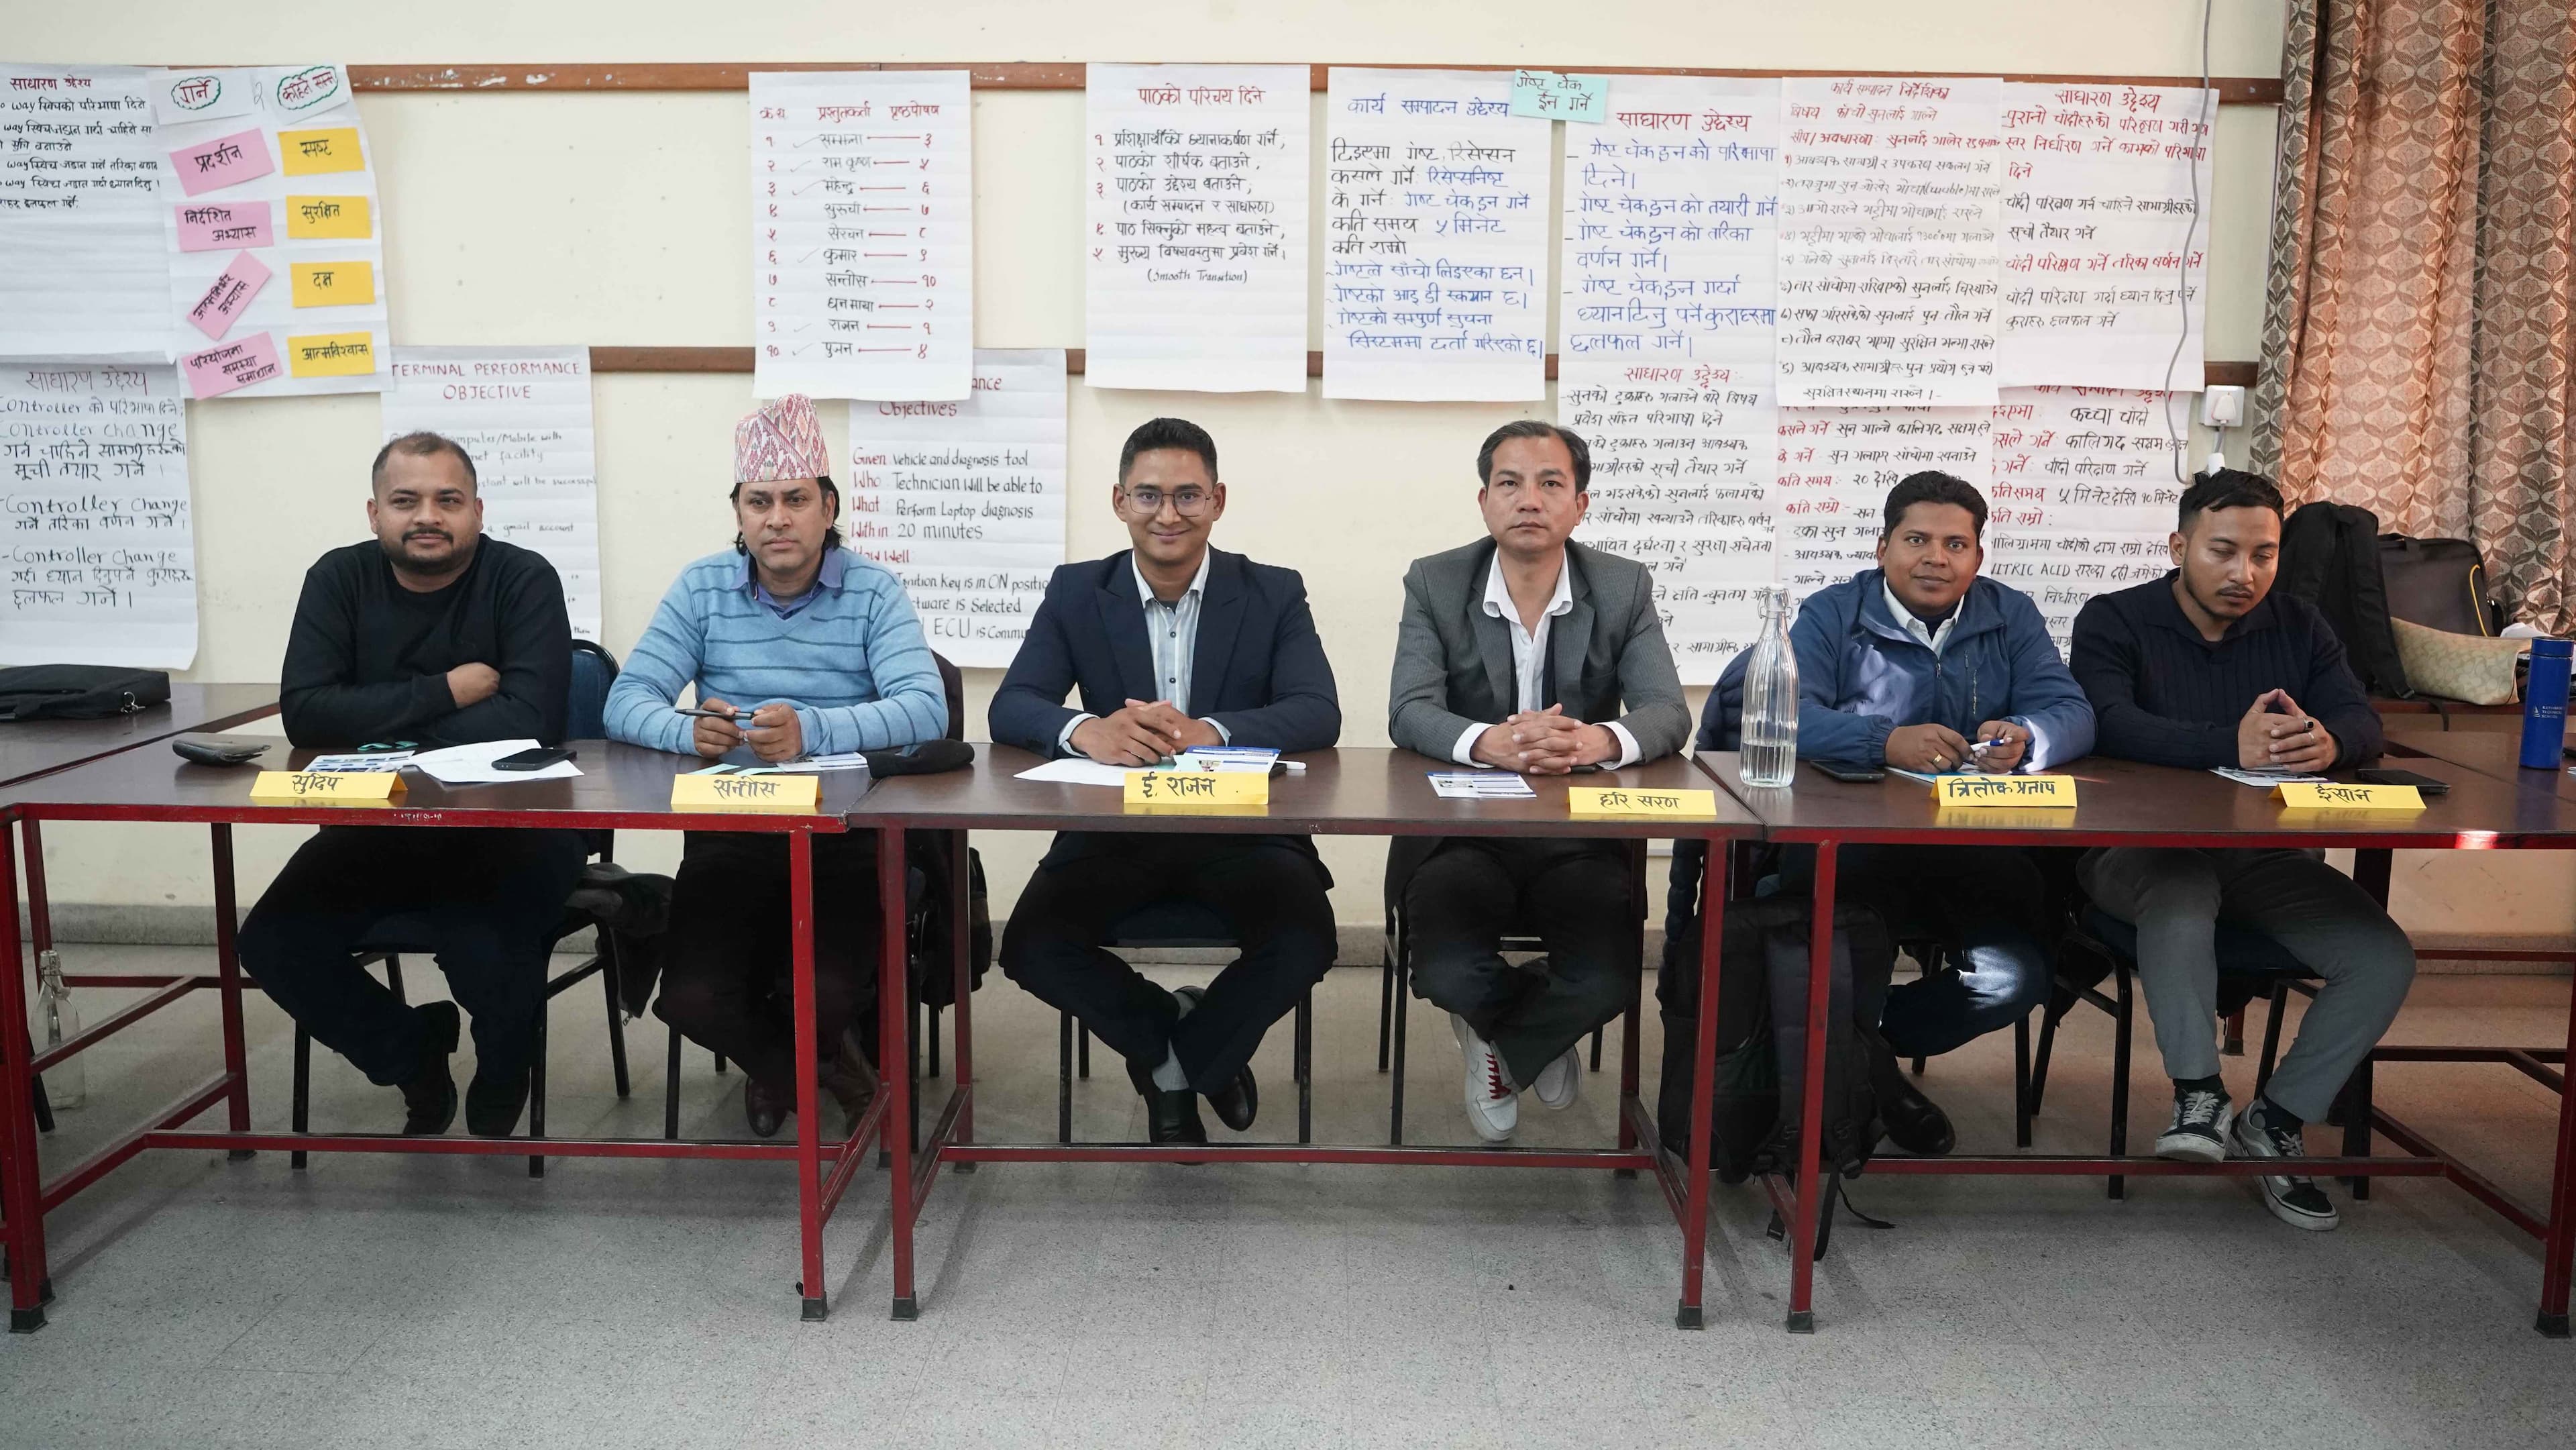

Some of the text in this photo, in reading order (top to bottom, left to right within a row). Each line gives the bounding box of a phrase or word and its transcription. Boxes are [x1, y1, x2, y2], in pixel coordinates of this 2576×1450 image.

[1137, 83, 1266, 106] पाठको परिचय दिने
[2055, 90, 2111, 107] साधारण
[12, 102, 35, 112] way
[1347, 93, 1386, 115] कार्य
[4, 124, 23, 133] way
[1617, 113, 1691, 131] साधारण
[7, 160, 28, 170] way
[193, 144, 243, 172] प्रदर्शन
[1114, 150, 1156, 168] पाठको
[6, 180, 25, 189] way
[1116, 172, 1155, 192] पाठको
[301, 202, 340, 224] सुरक्षित
[1212, 201, 1222, 211] र
[1709, 193, 1750, 217] तयारी
[1116, 222, 1136, 236] पाठ
[1332, 209, 1368, 232] कति
[1373, 217, 1419, 231] समय
[1708, 221, 1754, 240] तरिका
[1332, 234, 1364, 254] कति
[824, 248, 857, 264] कुमार
[313, 271, 334, 289] दक्ष
[392, 362, 580, 376] TERMINAL PERFORMANCE
[1624, 367, 1684, 382] साधारण
[25, 371, 92, 393] साधारण
[443, 385, 531, 400] OBJECTIVE
[879, 401, 957, 418] Objectives
[500, 449, 543, 464] facility
[853, 447, 886, 465] Given
[930, 448, 950, 465] and
[952, 449, 999, 469] diagnosis
[1004, 450, 1028, 466] tool
[60, 462, 101, 480] तयार
[535, 477, 545, 485] be
[854, 472, 1042, 493] Who Technician be able to
[2014, 487, 2047, 501] समय
[852, 497, 1033, 520] What Perform Laptop diagnosis
[504, 522, 530, 536] gmail
[898, 523, 983, 539] 20 minutes
[13, 546, 104, 564] Controller
[885, 550, 910, 563] Well
[2041, 563, 2070, 576] ACID
[989, 574, 1008, 589] ON
[972, 599, 1021, 613] Selected
[934, 618, 971, 637] ECU
[292, 774, 343, 794] सुदिप
[1167, 777, 1216, 797] राजन
[1598, 792, 1631, 809] हरि
